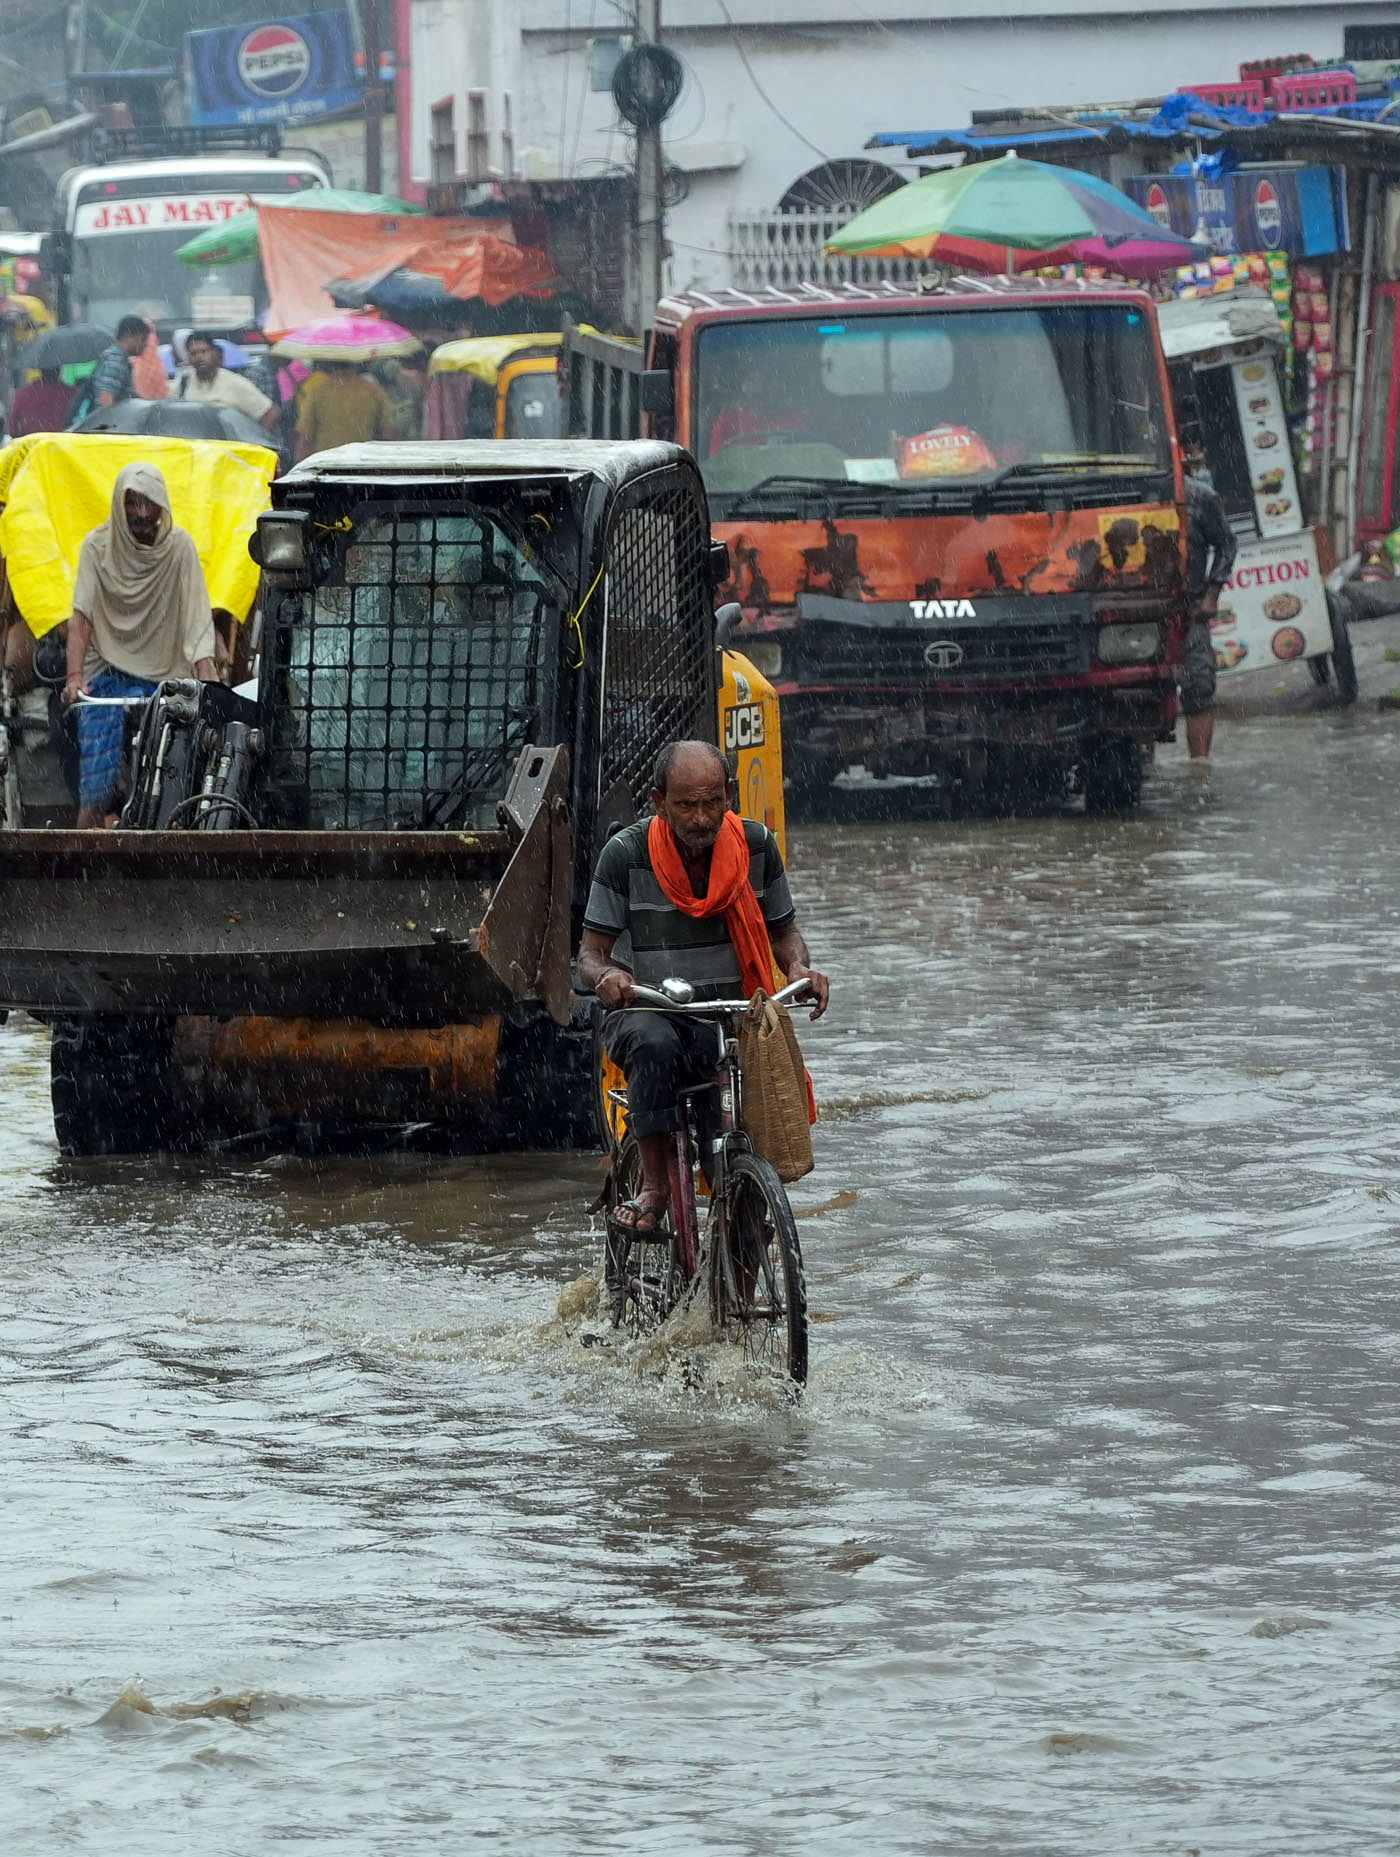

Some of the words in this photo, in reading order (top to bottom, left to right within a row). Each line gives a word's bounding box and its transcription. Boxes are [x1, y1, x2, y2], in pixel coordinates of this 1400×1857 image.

[245, 51, 306, 71] PEPSI
[93, 204, 149, 228] JAY
[910, 435, 971, 454] LOVELY
[909, 599, 977, 619] TATA
[725, 705, 765, 749] JCB
